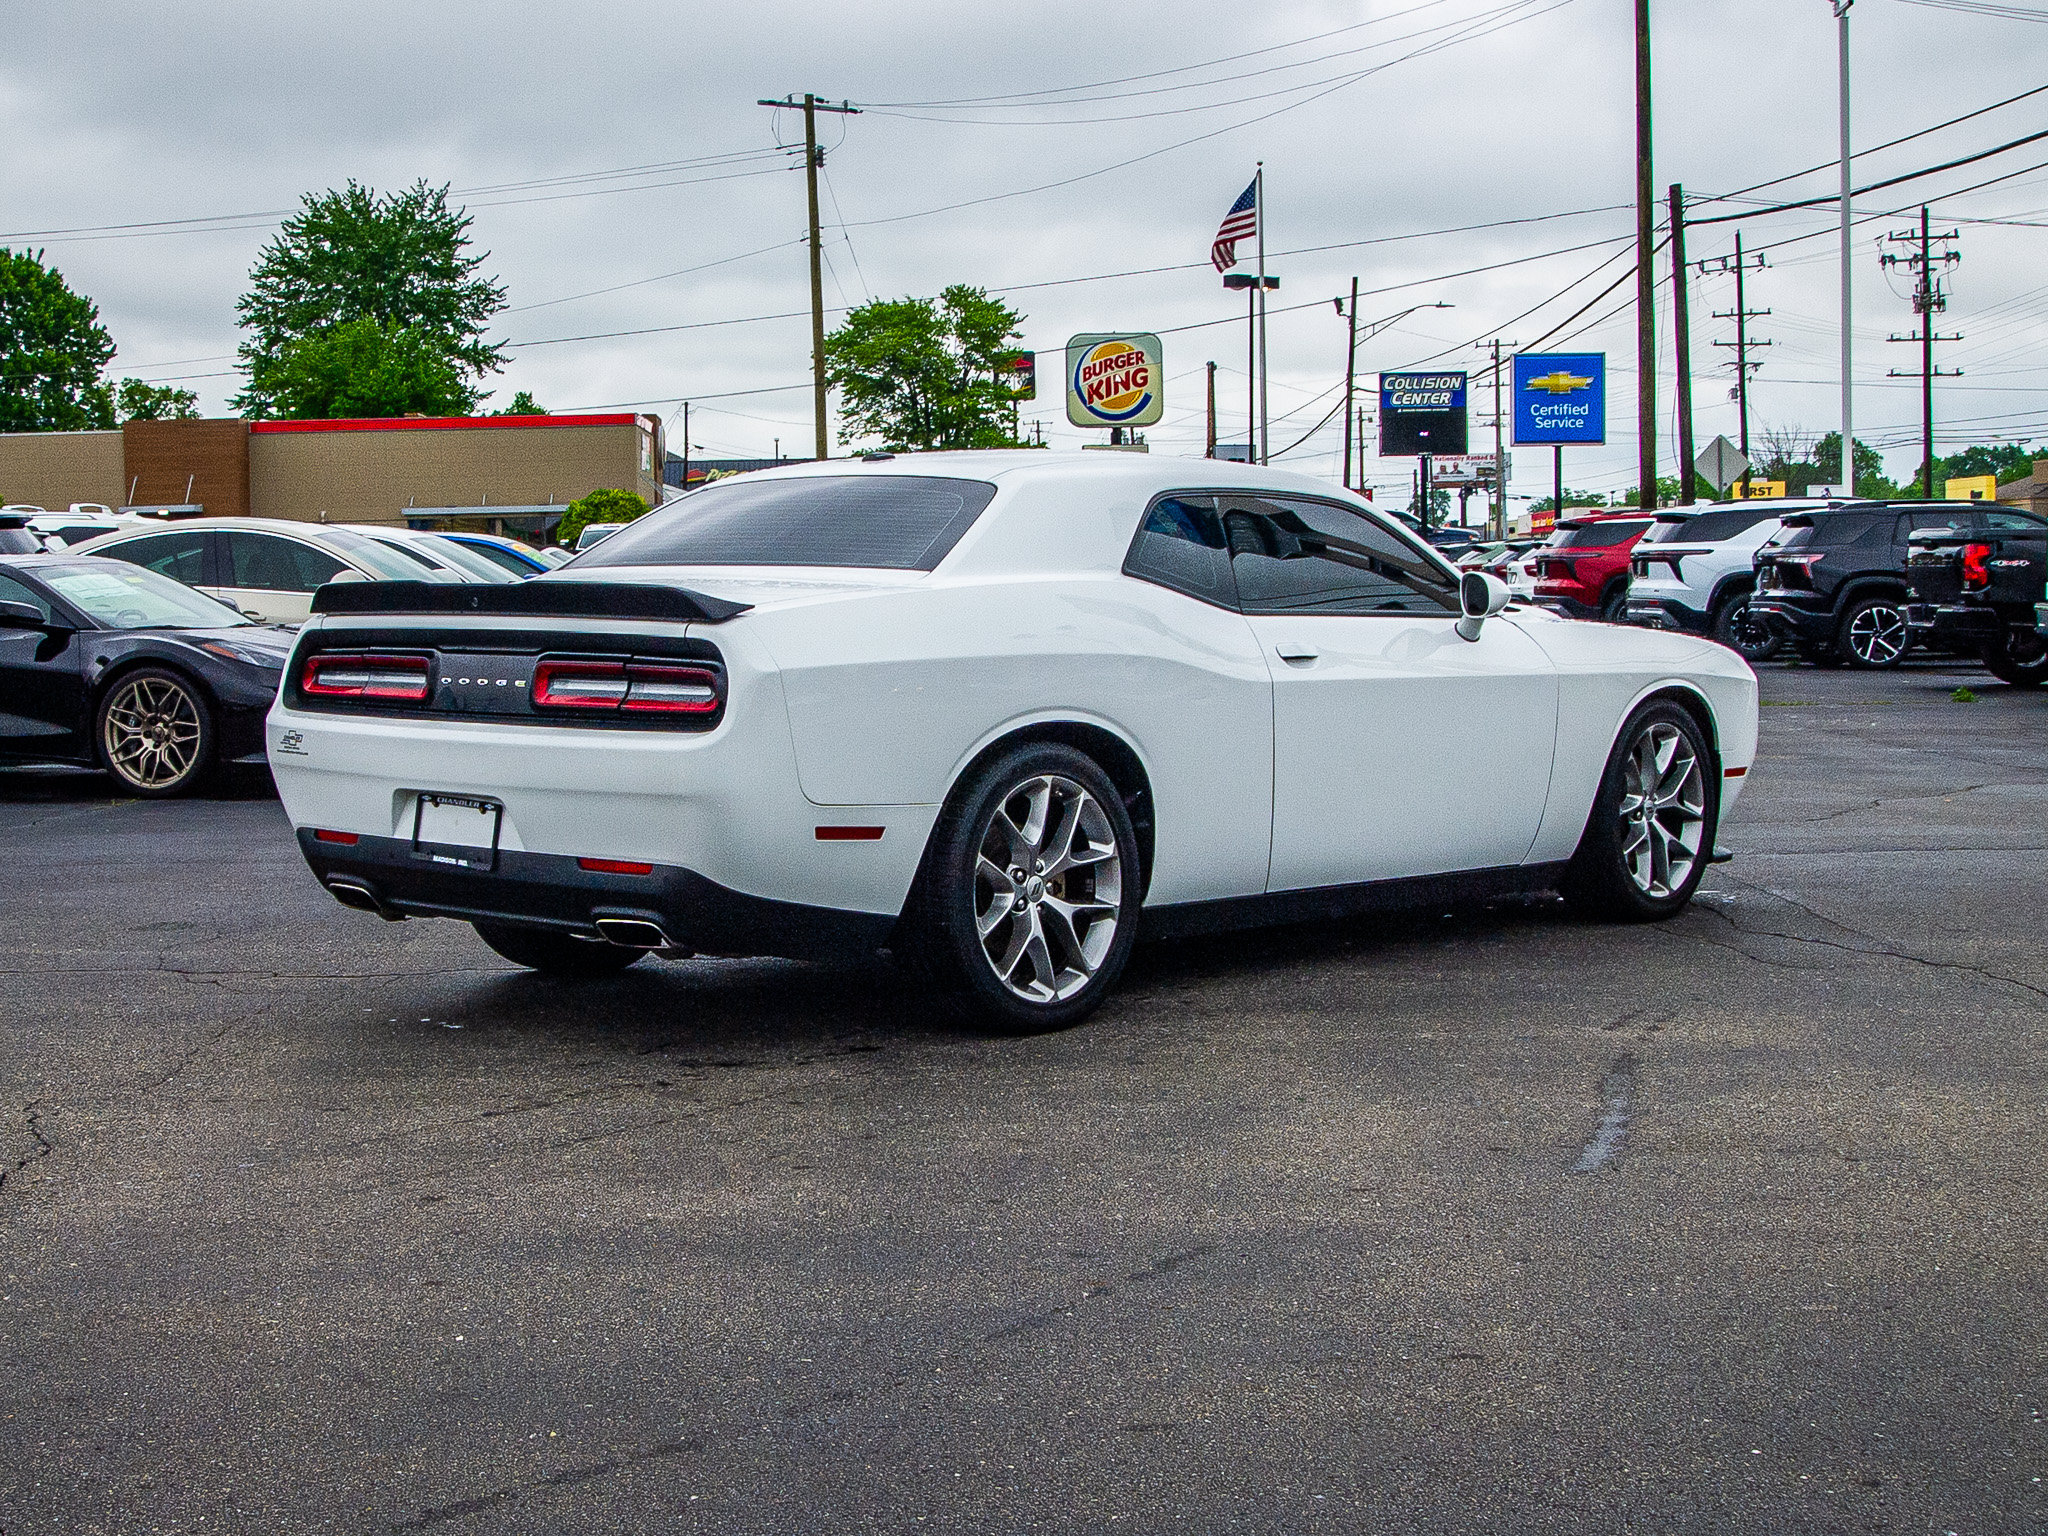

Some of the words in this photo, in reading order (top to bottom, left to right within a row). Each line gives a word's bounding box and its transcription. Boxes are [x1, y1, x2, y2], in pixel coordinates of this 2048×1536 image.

[1082, 350, 1145, 382] BURGER
[1087, 367, 1149, 405] KING
[1383, 375, 1462, 390] COLLISION
[1391, 391, 1452, 406] CENTER
[1530, 403, 1589, 416] Certified
[1535, 416, 1584, 428] Service
[1739, 486, 1773, 497] RST
[441, 677, 526, 688] DODGE
[437, 797, 480, 808] CHANDLER
